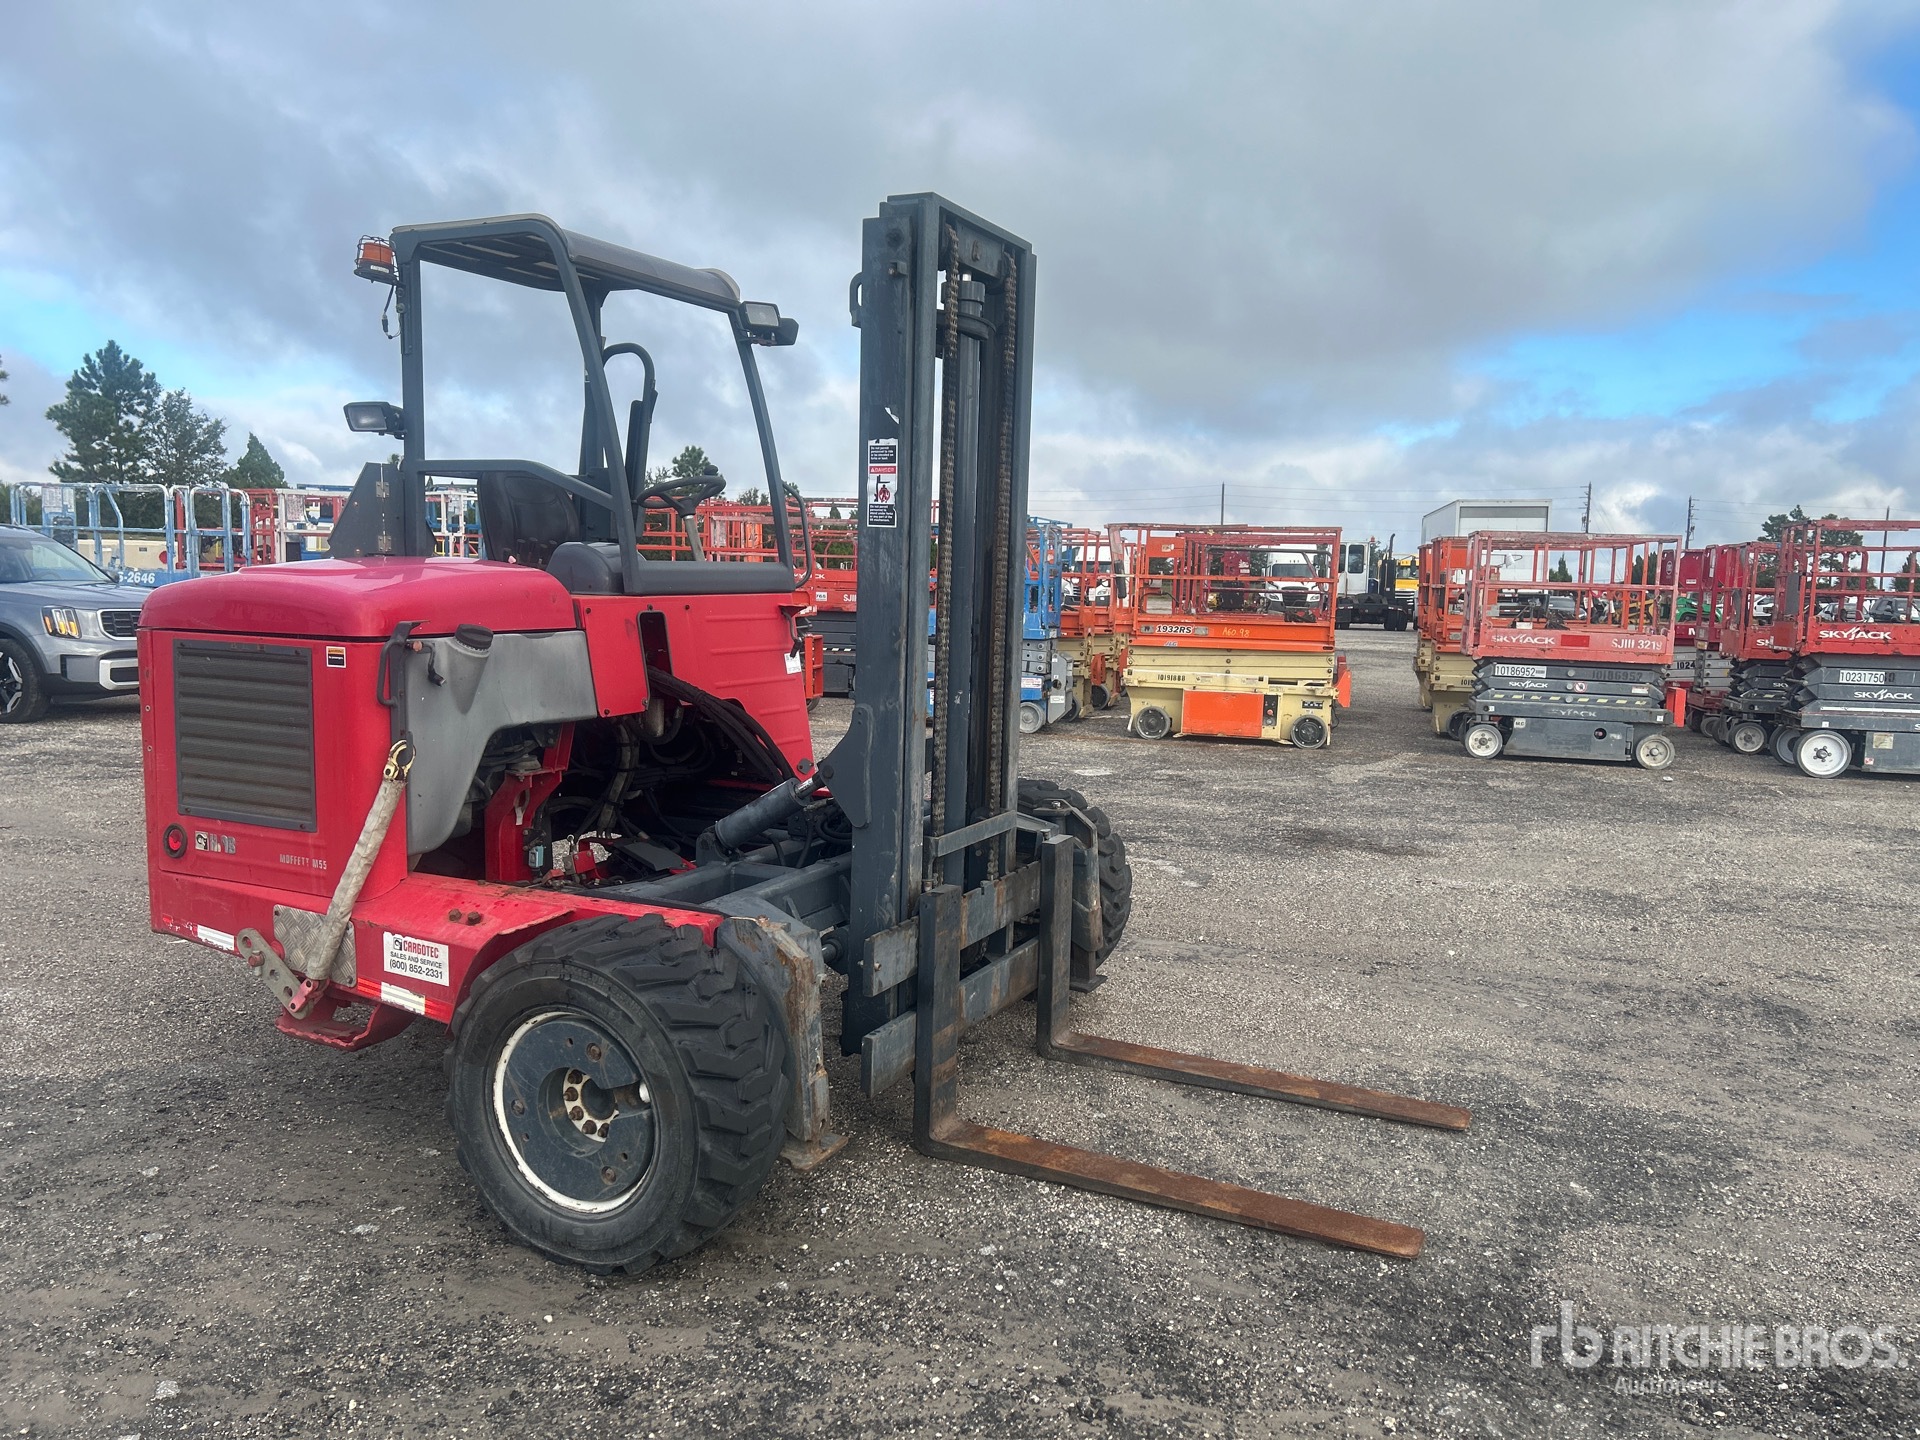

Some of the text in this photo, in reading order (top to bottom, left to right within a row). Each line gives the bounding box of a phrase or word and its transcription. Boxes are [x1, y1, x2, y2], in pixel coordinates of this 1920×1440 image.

[1156, 625, 1192, 635] 1932RS
[1819, 627, 1892, 640] SKYJACK
[1490, 633, 1556, 645] SKYJACK
[1496, 666, 1536, 677] 10186952
[1840, 672, 1885, 683] 10231750
[1508, 680, 1548, 689] SKYJACK
[1854, 688, 1914, 700] SKYJACK
[279, 853, 327, 870] MOFFETT M55
[403, 940, 439, 959] CARGOTEC
[390, 951, 442, 969] SALES AND SERVICE
[390, 959, 443, 979] (800) 852-2331
